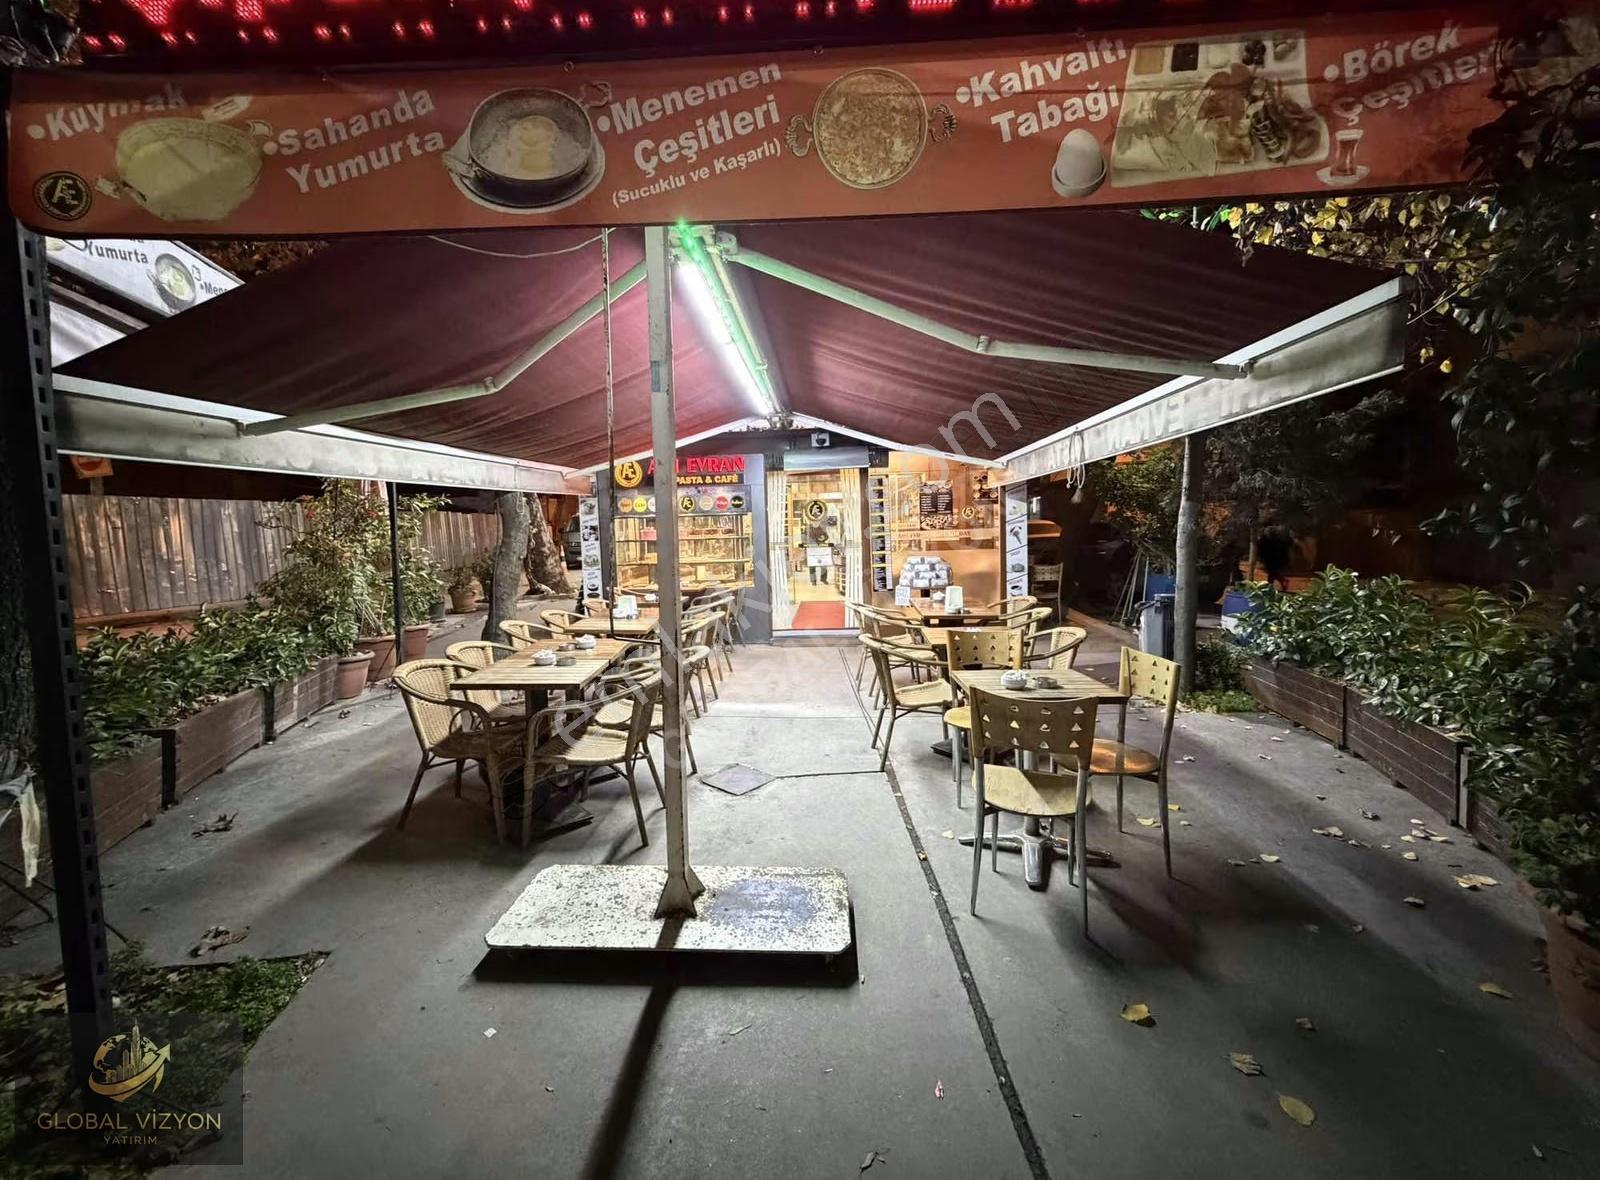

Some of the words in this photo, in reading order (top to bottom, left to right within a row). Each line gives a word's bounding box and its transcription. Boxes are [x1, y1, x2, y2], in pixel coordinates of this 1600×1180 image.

[969, 37, 1127, 108] Kahvaltı
[1343, 26, 1460, 84] Börek
[612, 64, 782, 135] Menemen
[990, 82, 1120, 144] Tabağı
[285, 132, 447, 195] Yumurta
[634, 95, 781, 178] Çeşitleri
[612, 171, 687, 207] (Sucuklu
[689, 166, 710, 181] ve
[713, 138, 782, 174] Kaşarlı)
[676, 475, 703, 485] PASTA
[705, 475, 713, 484] &
[687, 457, 745, 474] EVRAN
